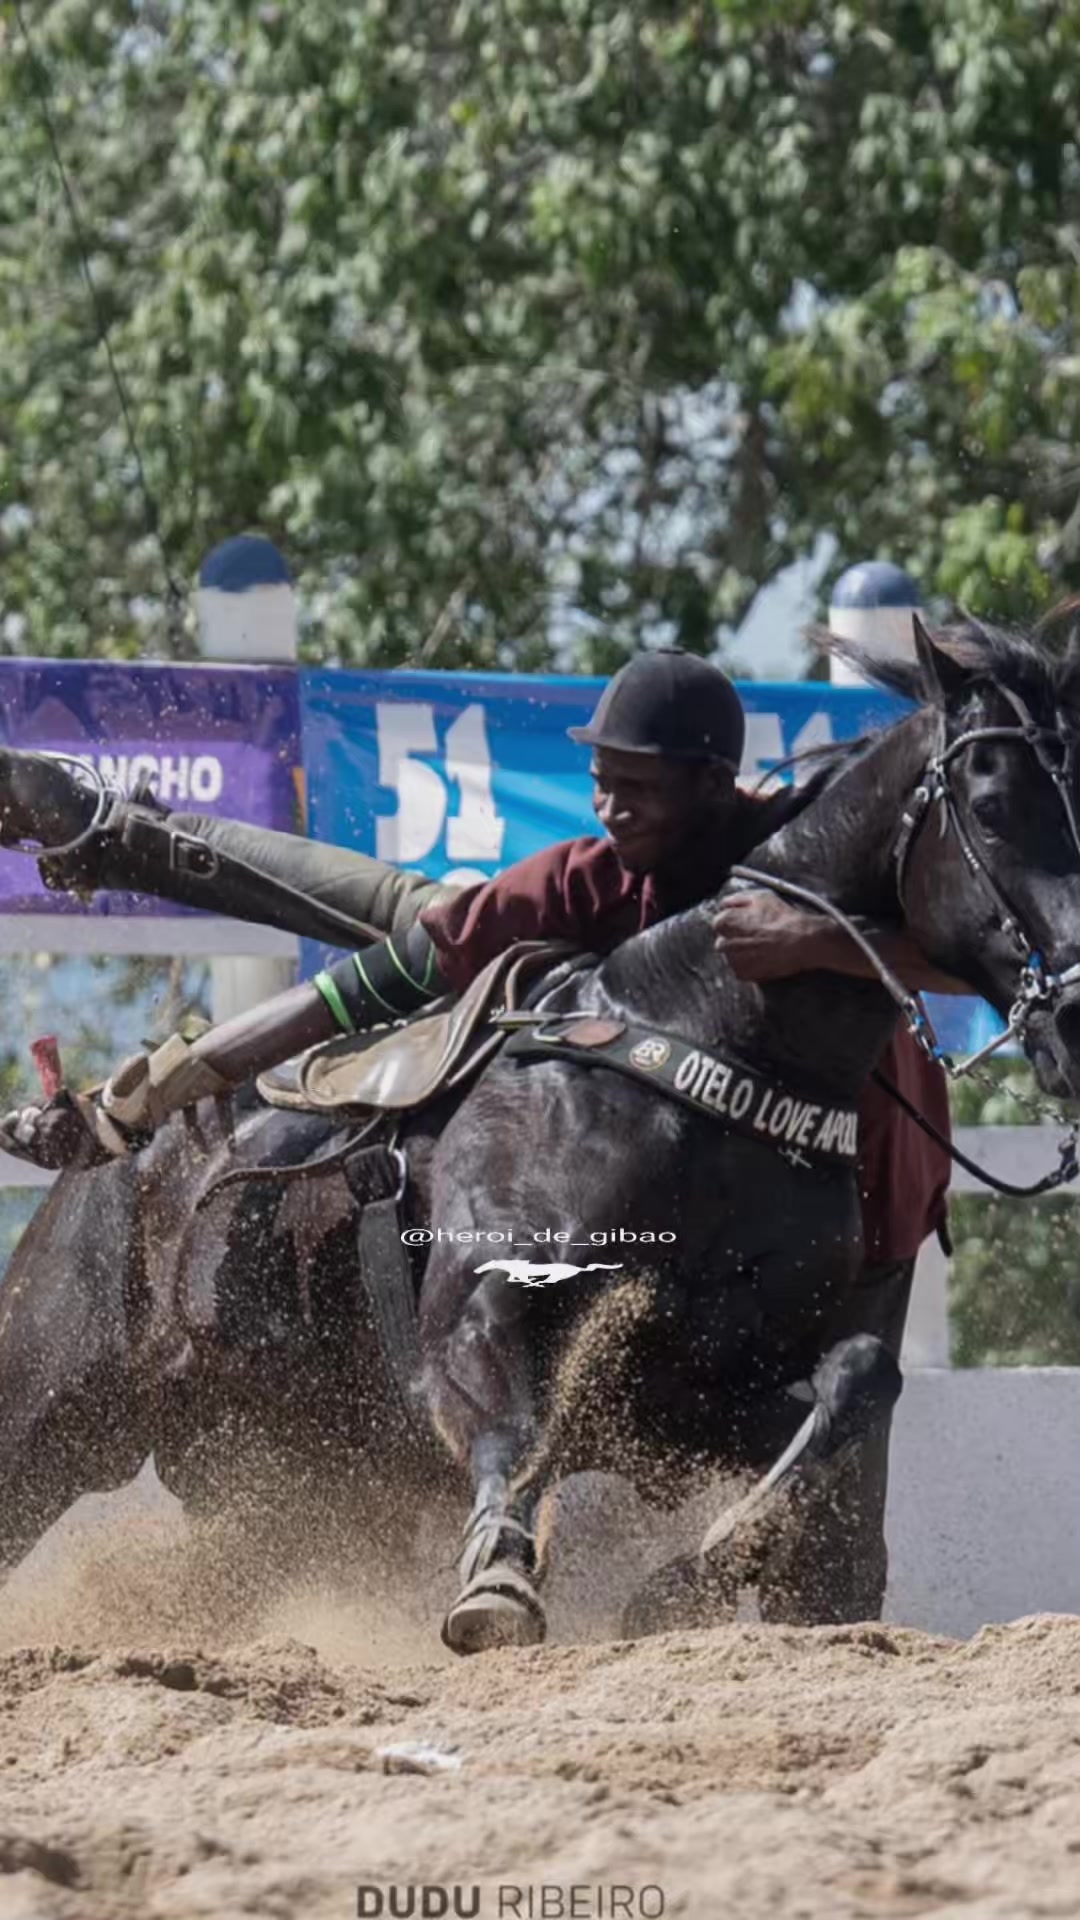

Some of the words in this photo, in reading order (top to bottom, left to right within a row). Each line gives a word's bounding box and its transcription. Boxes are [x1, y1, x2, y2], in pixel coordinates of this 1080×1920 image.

[376, 703, 503, 862] 51
[673, 1050, 753, 1119] OTELO
[753, 1088, 822, 1145] LOVE
